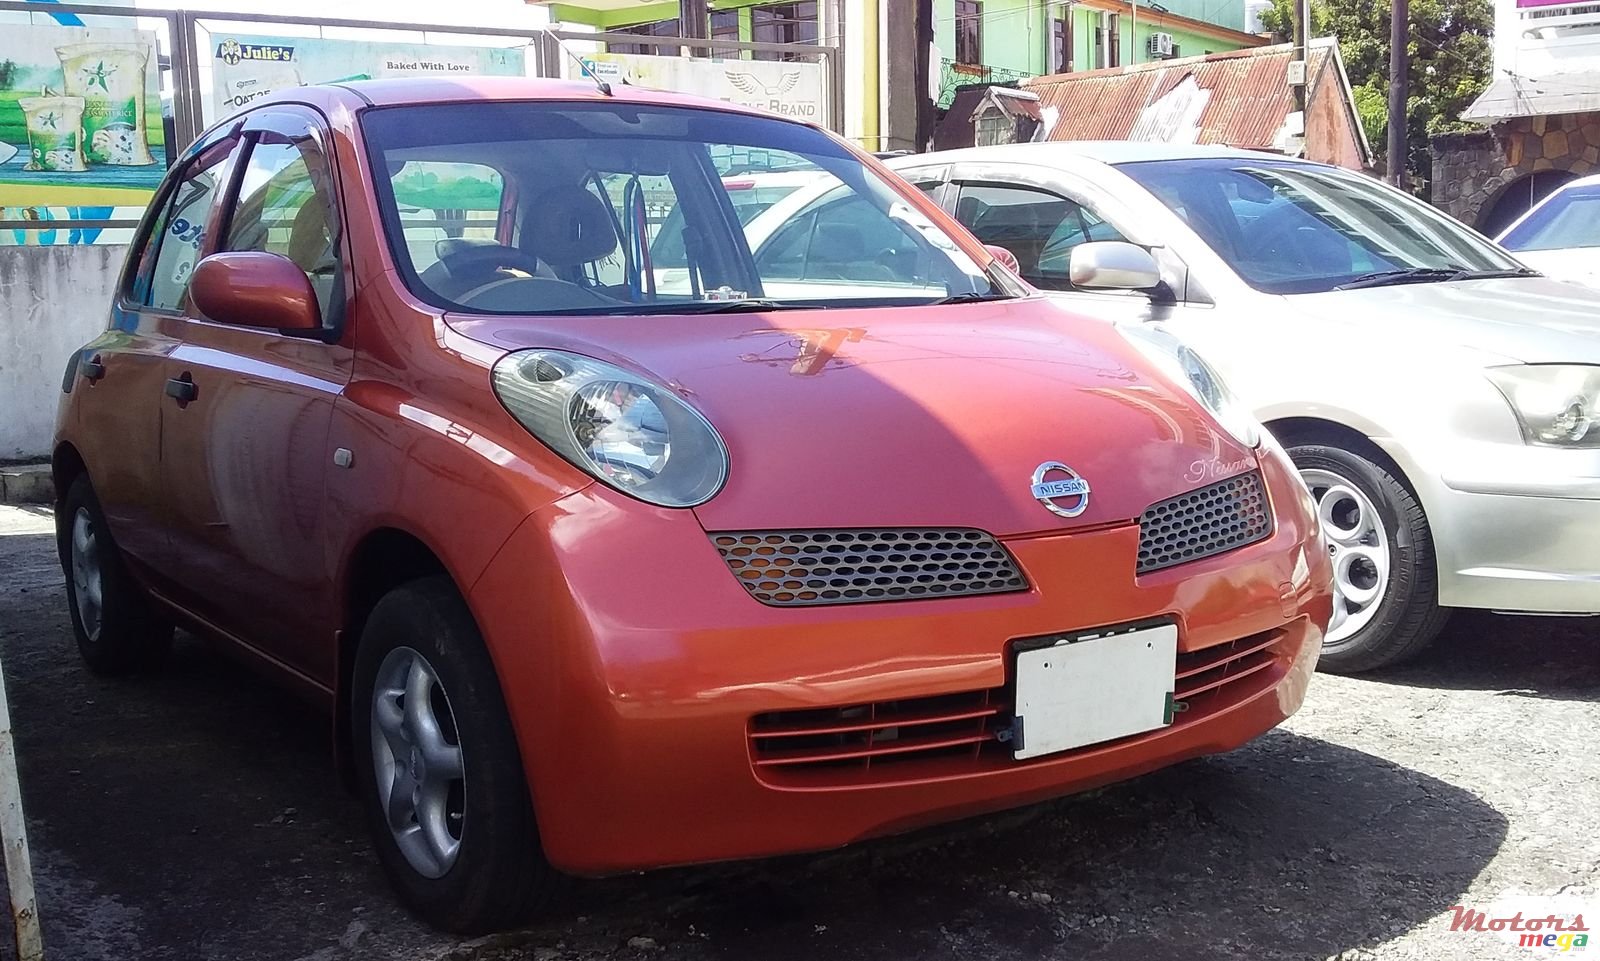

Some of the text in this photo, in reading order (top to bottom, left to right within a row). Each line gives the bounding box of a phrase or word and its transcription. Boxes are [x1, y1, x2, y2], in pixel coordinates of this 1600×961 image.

[243, 46, 290, 60] Julie's
[386, 61, 470, 71] Baked With Love
[769, 99, 815, 116] BRAND
[1040, 481, 1086, 495] NISSAN
